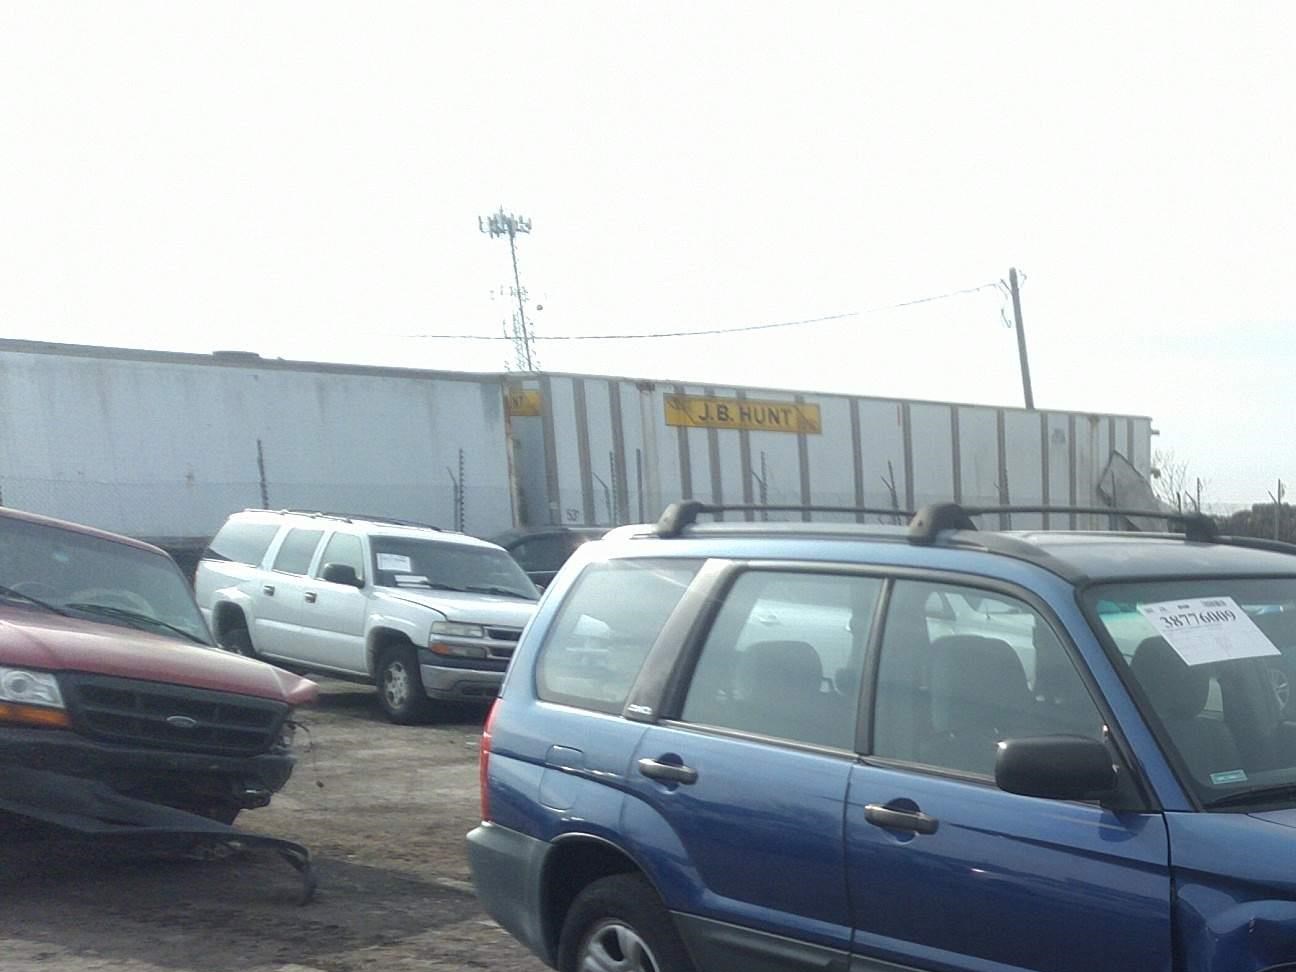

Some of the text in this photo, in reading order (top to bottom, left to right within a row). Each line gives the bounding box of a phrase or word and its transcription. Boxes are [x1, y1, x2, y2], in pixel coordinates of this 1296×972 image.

[698, 402, 792, 425] J.B. HUNT
[1160, 609, 1236, 628] 38776009
